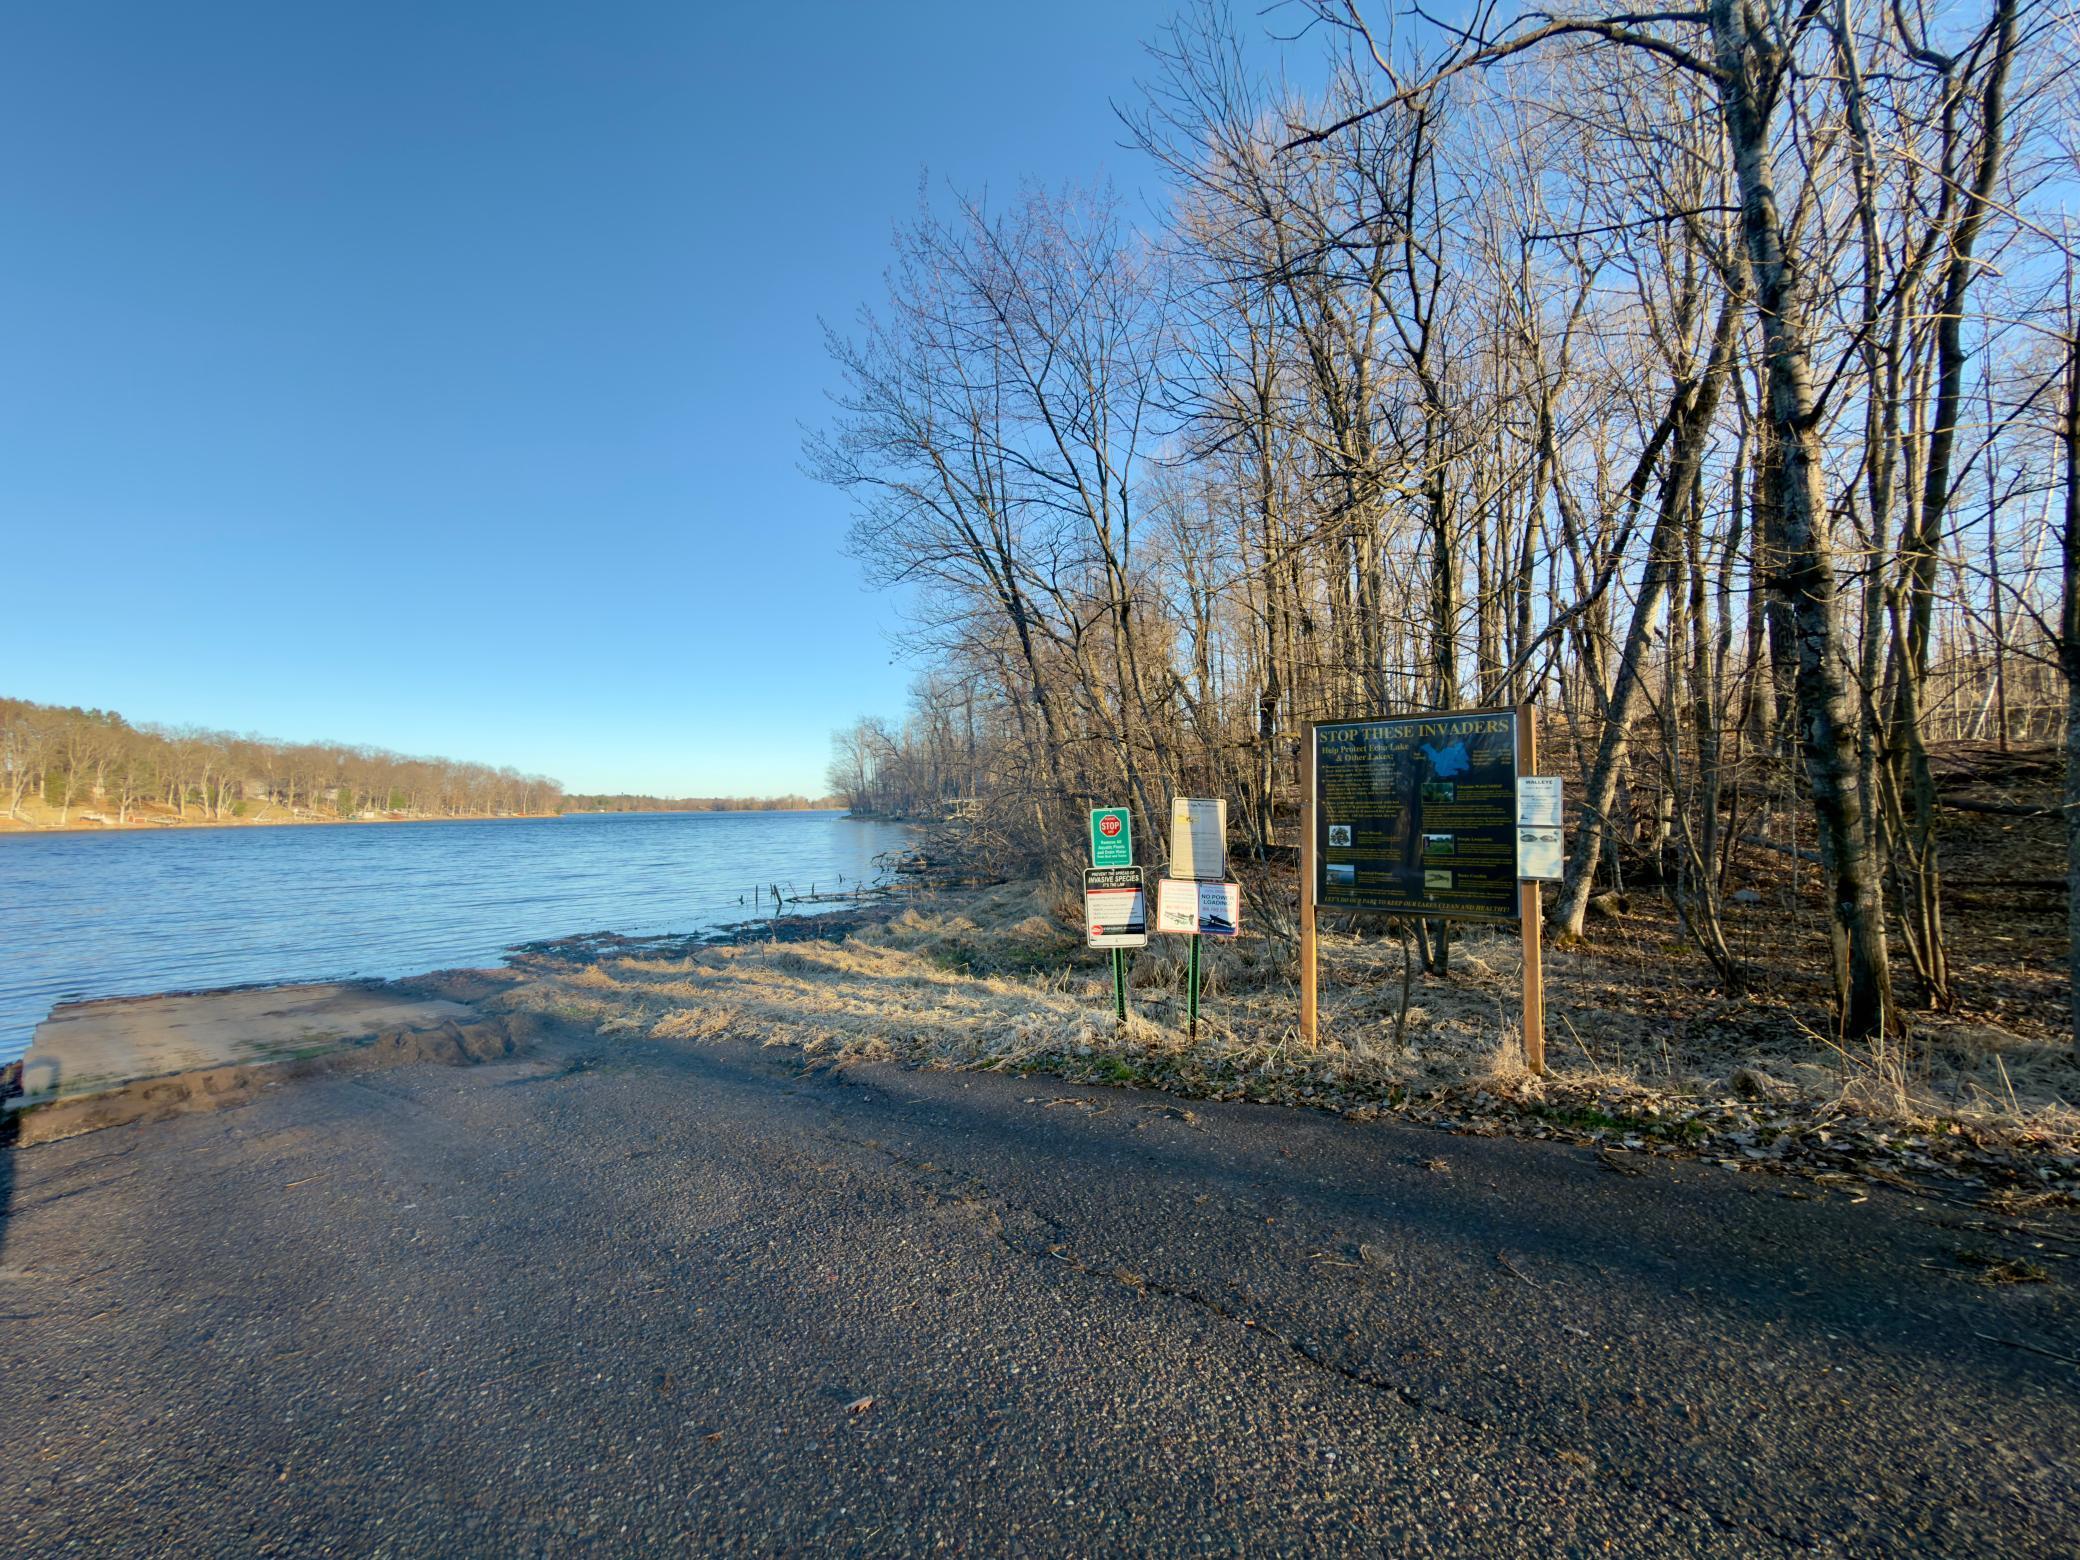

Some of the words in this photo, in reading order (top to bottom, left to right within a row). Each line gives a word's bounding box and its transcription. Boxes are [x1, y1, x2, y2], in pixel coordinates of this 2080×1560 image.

[1319, 729, 1358, 743] STOP
[1362, 725, 1414, 740] THESE
[1420, 719, 1510, 737] INVADERS
[1322, 746, 1339, 755] Help
[1340, 744, 1367, 753] Protect
[1390, 742, 1410, 751] Lake
[1336, 754, 1343, 762] &
[1344, 753, 1366, 761] Other
[1101, 821, 1120, 831] STOP
